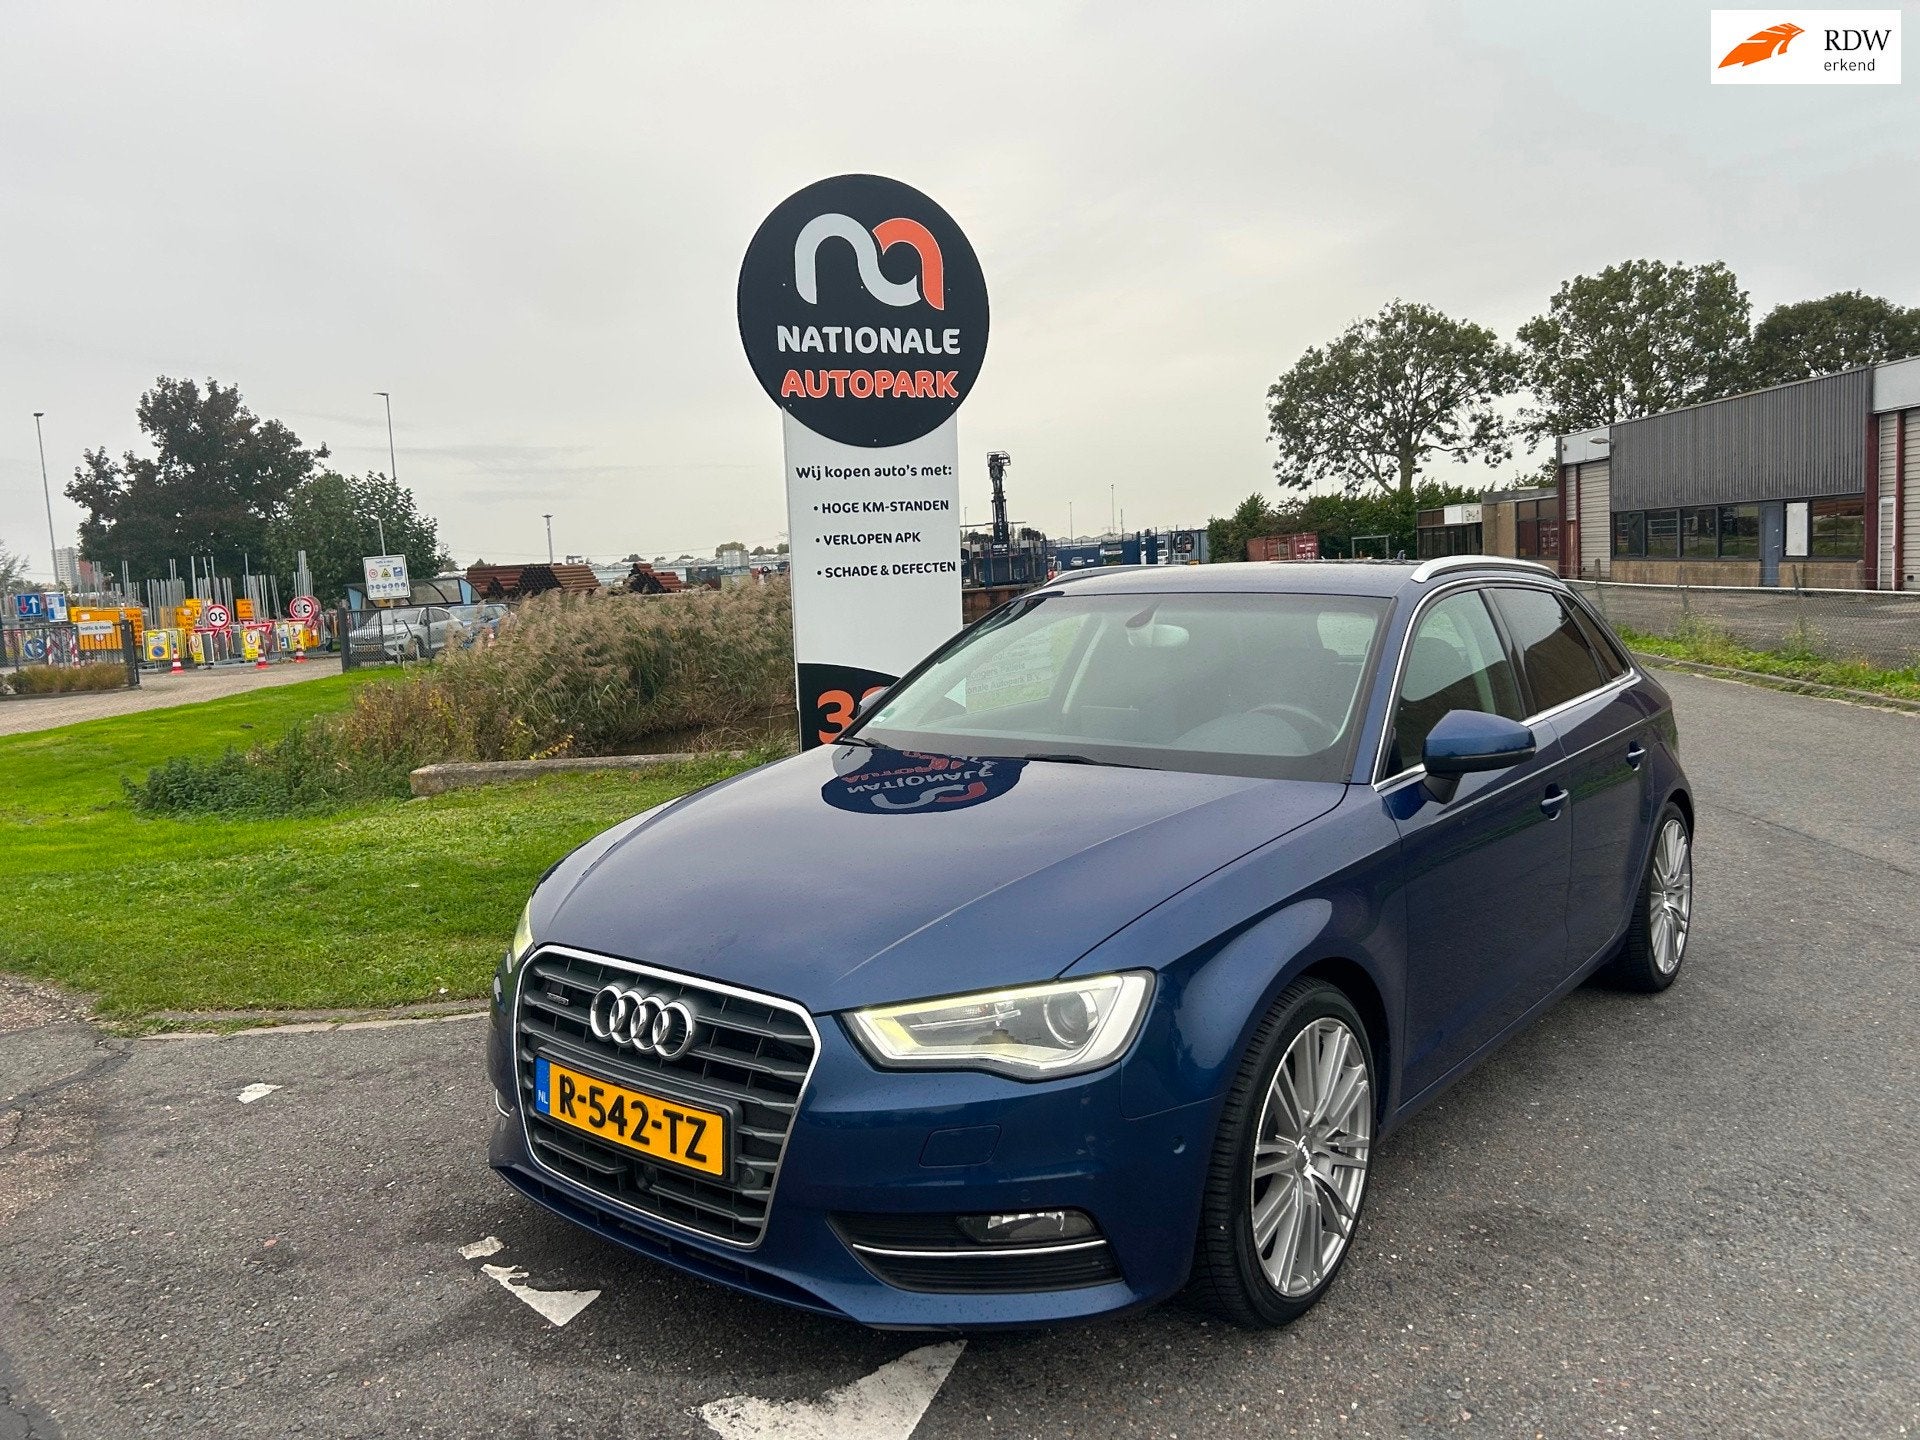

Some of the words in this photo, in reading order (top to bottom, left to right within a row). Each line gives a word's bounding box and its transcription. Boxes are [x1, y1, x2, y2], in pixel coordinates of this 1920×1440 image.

[777, 325, 960, 355] NATIONALE
[781, 369, 959, 398] AUTOPARK
[796, 465, 821, 480] Wij
[825, 465, 871, 480] kopen
[874, 464, 917, 477] auto's
[921, 464, 952, 476] met:
[822, 502, 860, 514] HOGE
[862, 500, 949, 512] KM-STANDEN
[824, 533, 892, 545] VERLOPEN
[895, 532, 921, 543] APK
[825, 565, 878, 578] SCHADE
[880, 565, 889, 576] &
[892, 562, 956, 574] DEFECTEN
[537, 1088, 549, 1105] NL
[558, 1073, 707, 1163] R-542-TZ
